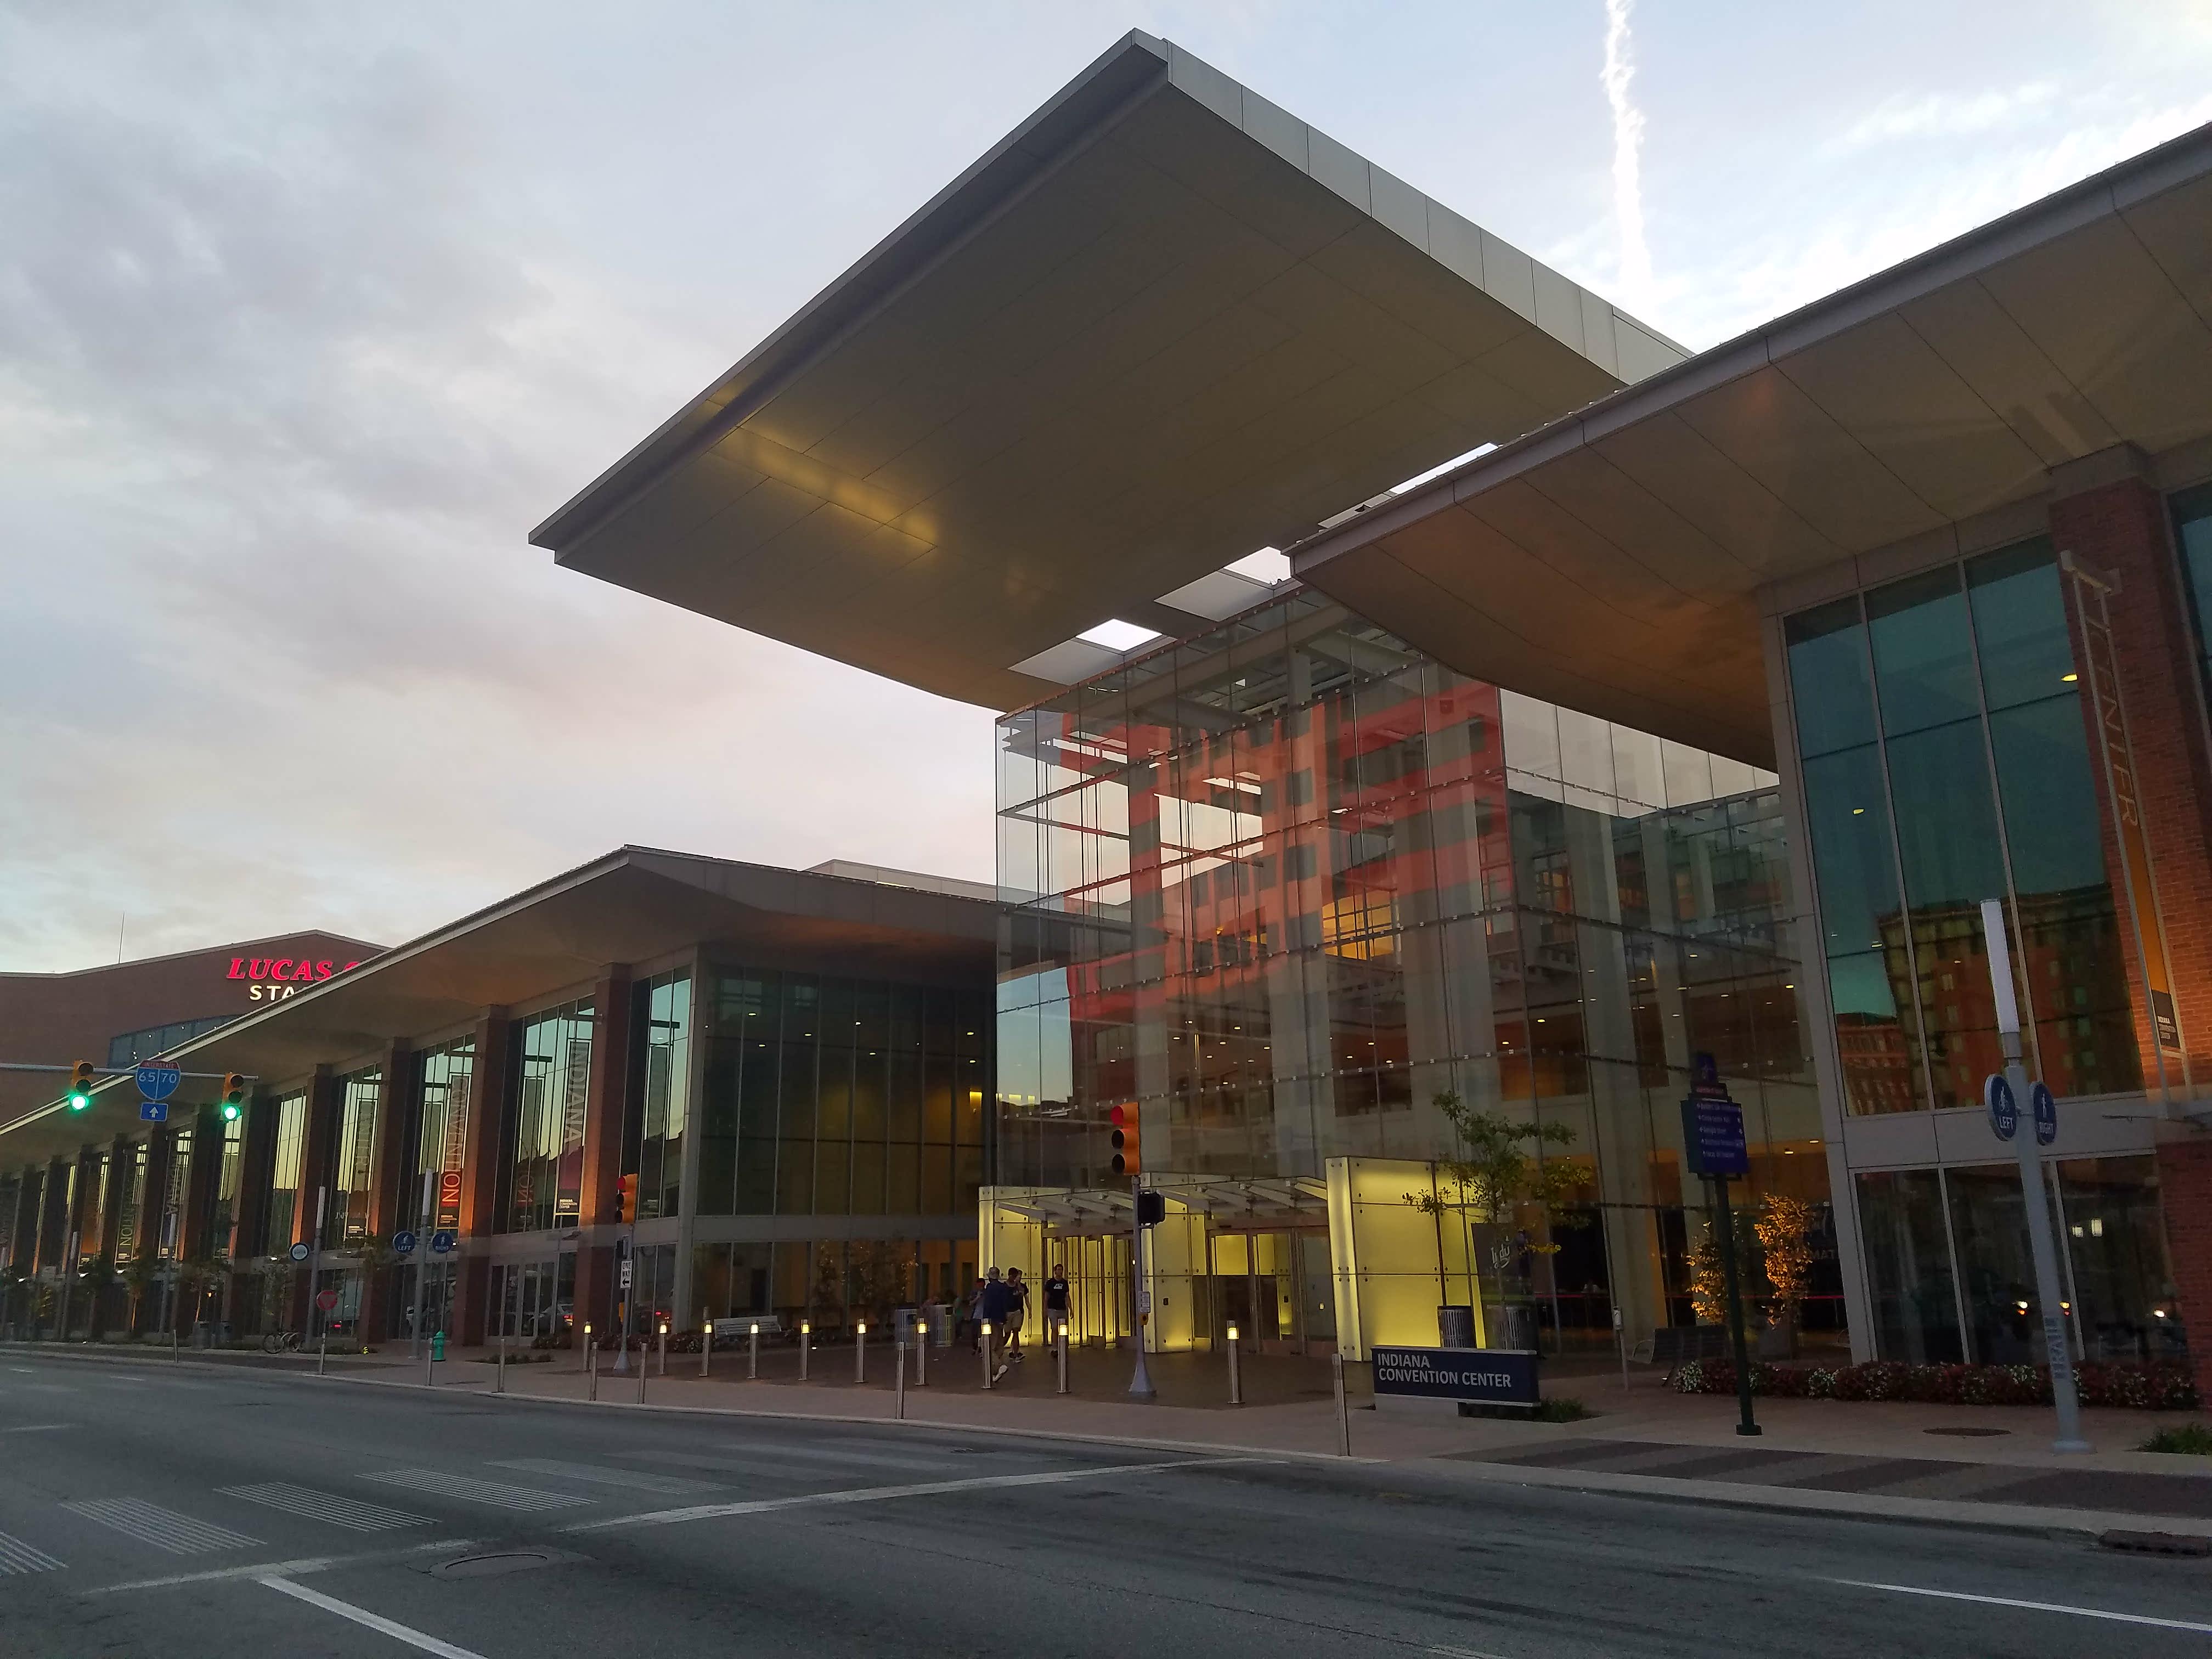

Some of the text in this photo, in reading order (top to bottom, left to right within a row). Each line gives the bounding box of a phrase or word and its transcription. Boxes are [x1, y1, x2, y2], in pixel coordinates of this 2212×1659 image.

[226, 957, 333, 981] LUCAS
[138, 1071, 177, 1084] 65 70
[1999, 1116, 2013, 1130] LEFT
[1377, 1353, 1430, 1368] INDIANA
[1379, 1368, 1512, 1388] CONVENTION CENTER
